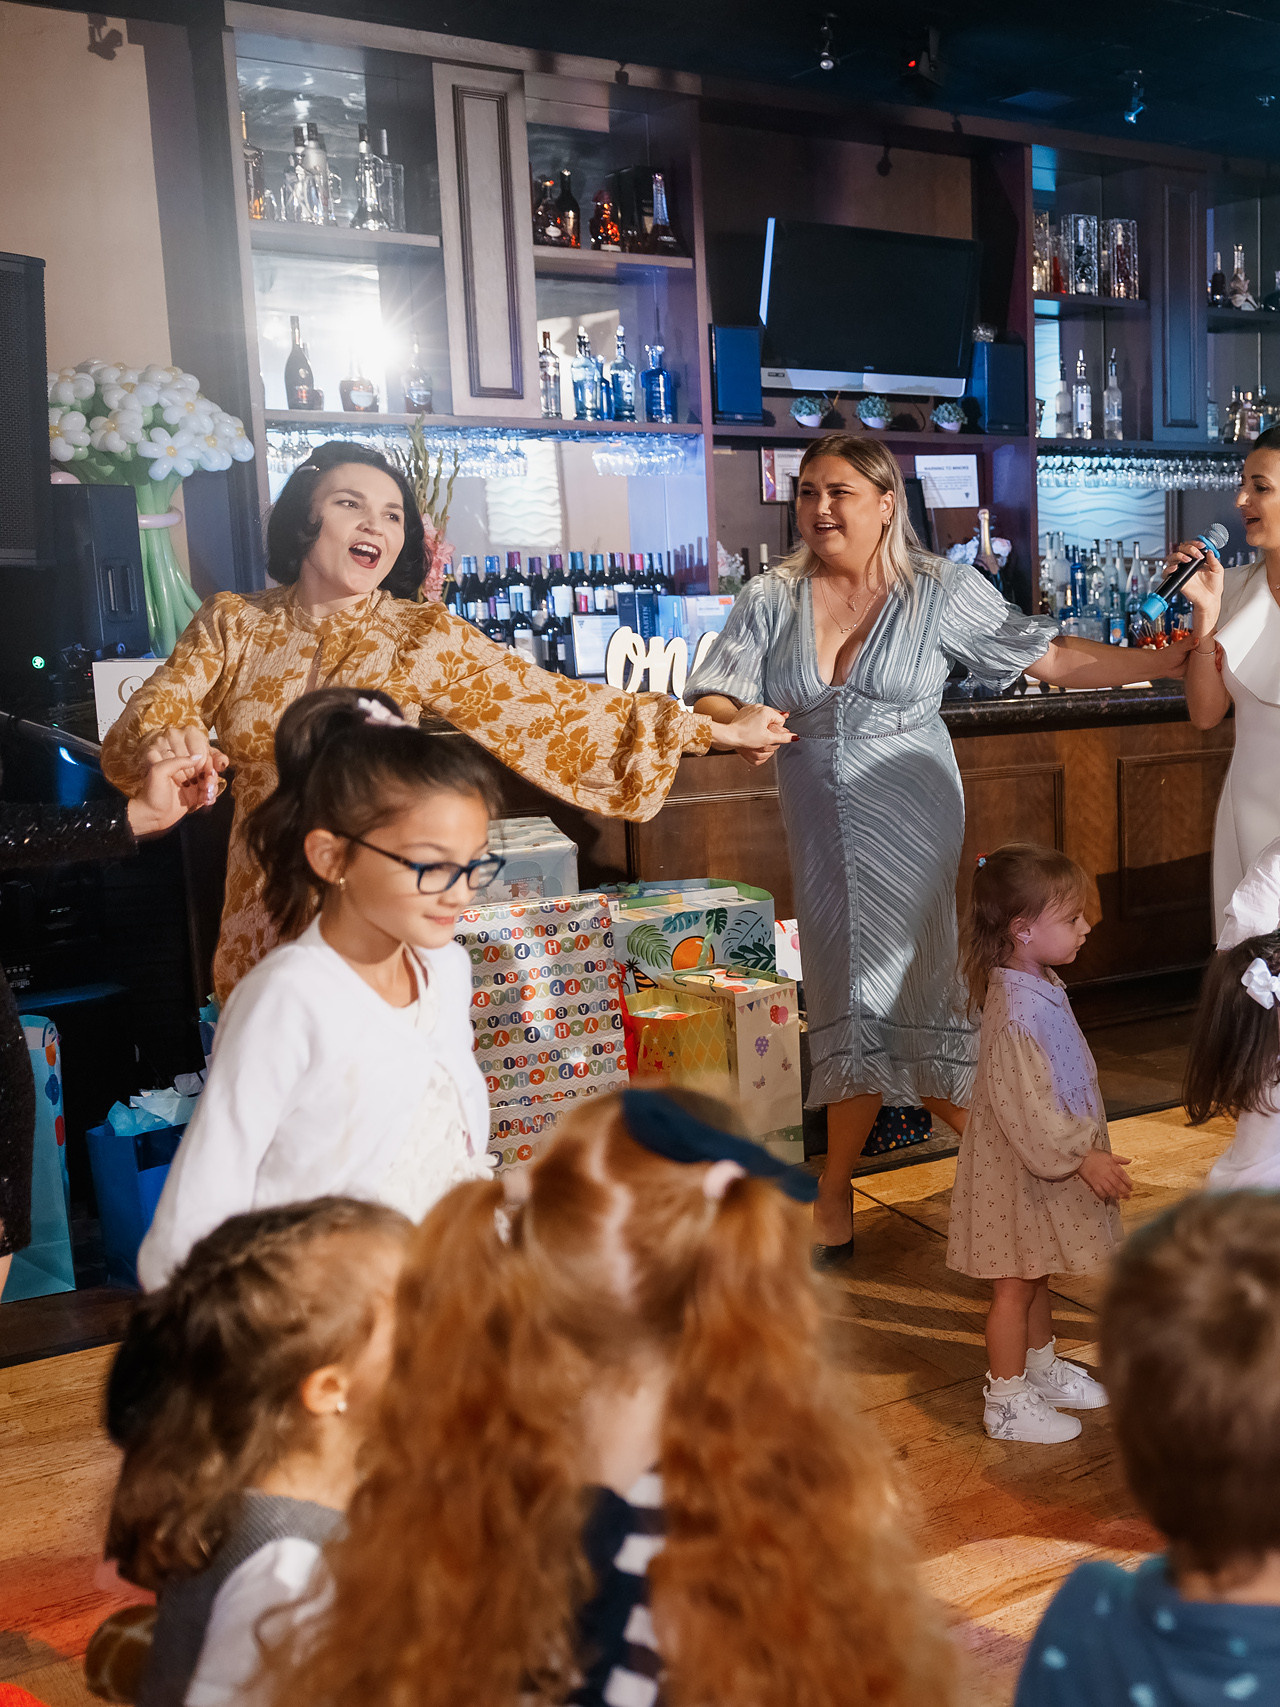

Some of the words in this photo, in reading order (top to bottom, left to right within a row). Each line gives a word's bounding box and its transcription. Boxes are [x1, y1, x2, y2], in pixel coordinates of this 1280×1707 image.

[642, 606, 650, 638] MARTIN
[485, 940, 559, 961] HAPPY
[473, 988, 520, 1006] HAP
[536, 977, 608, 997] HAPPY
[494, 1023, 569, 1046] HAPPY
[545, 1059, 616, 1081] HAPPY
